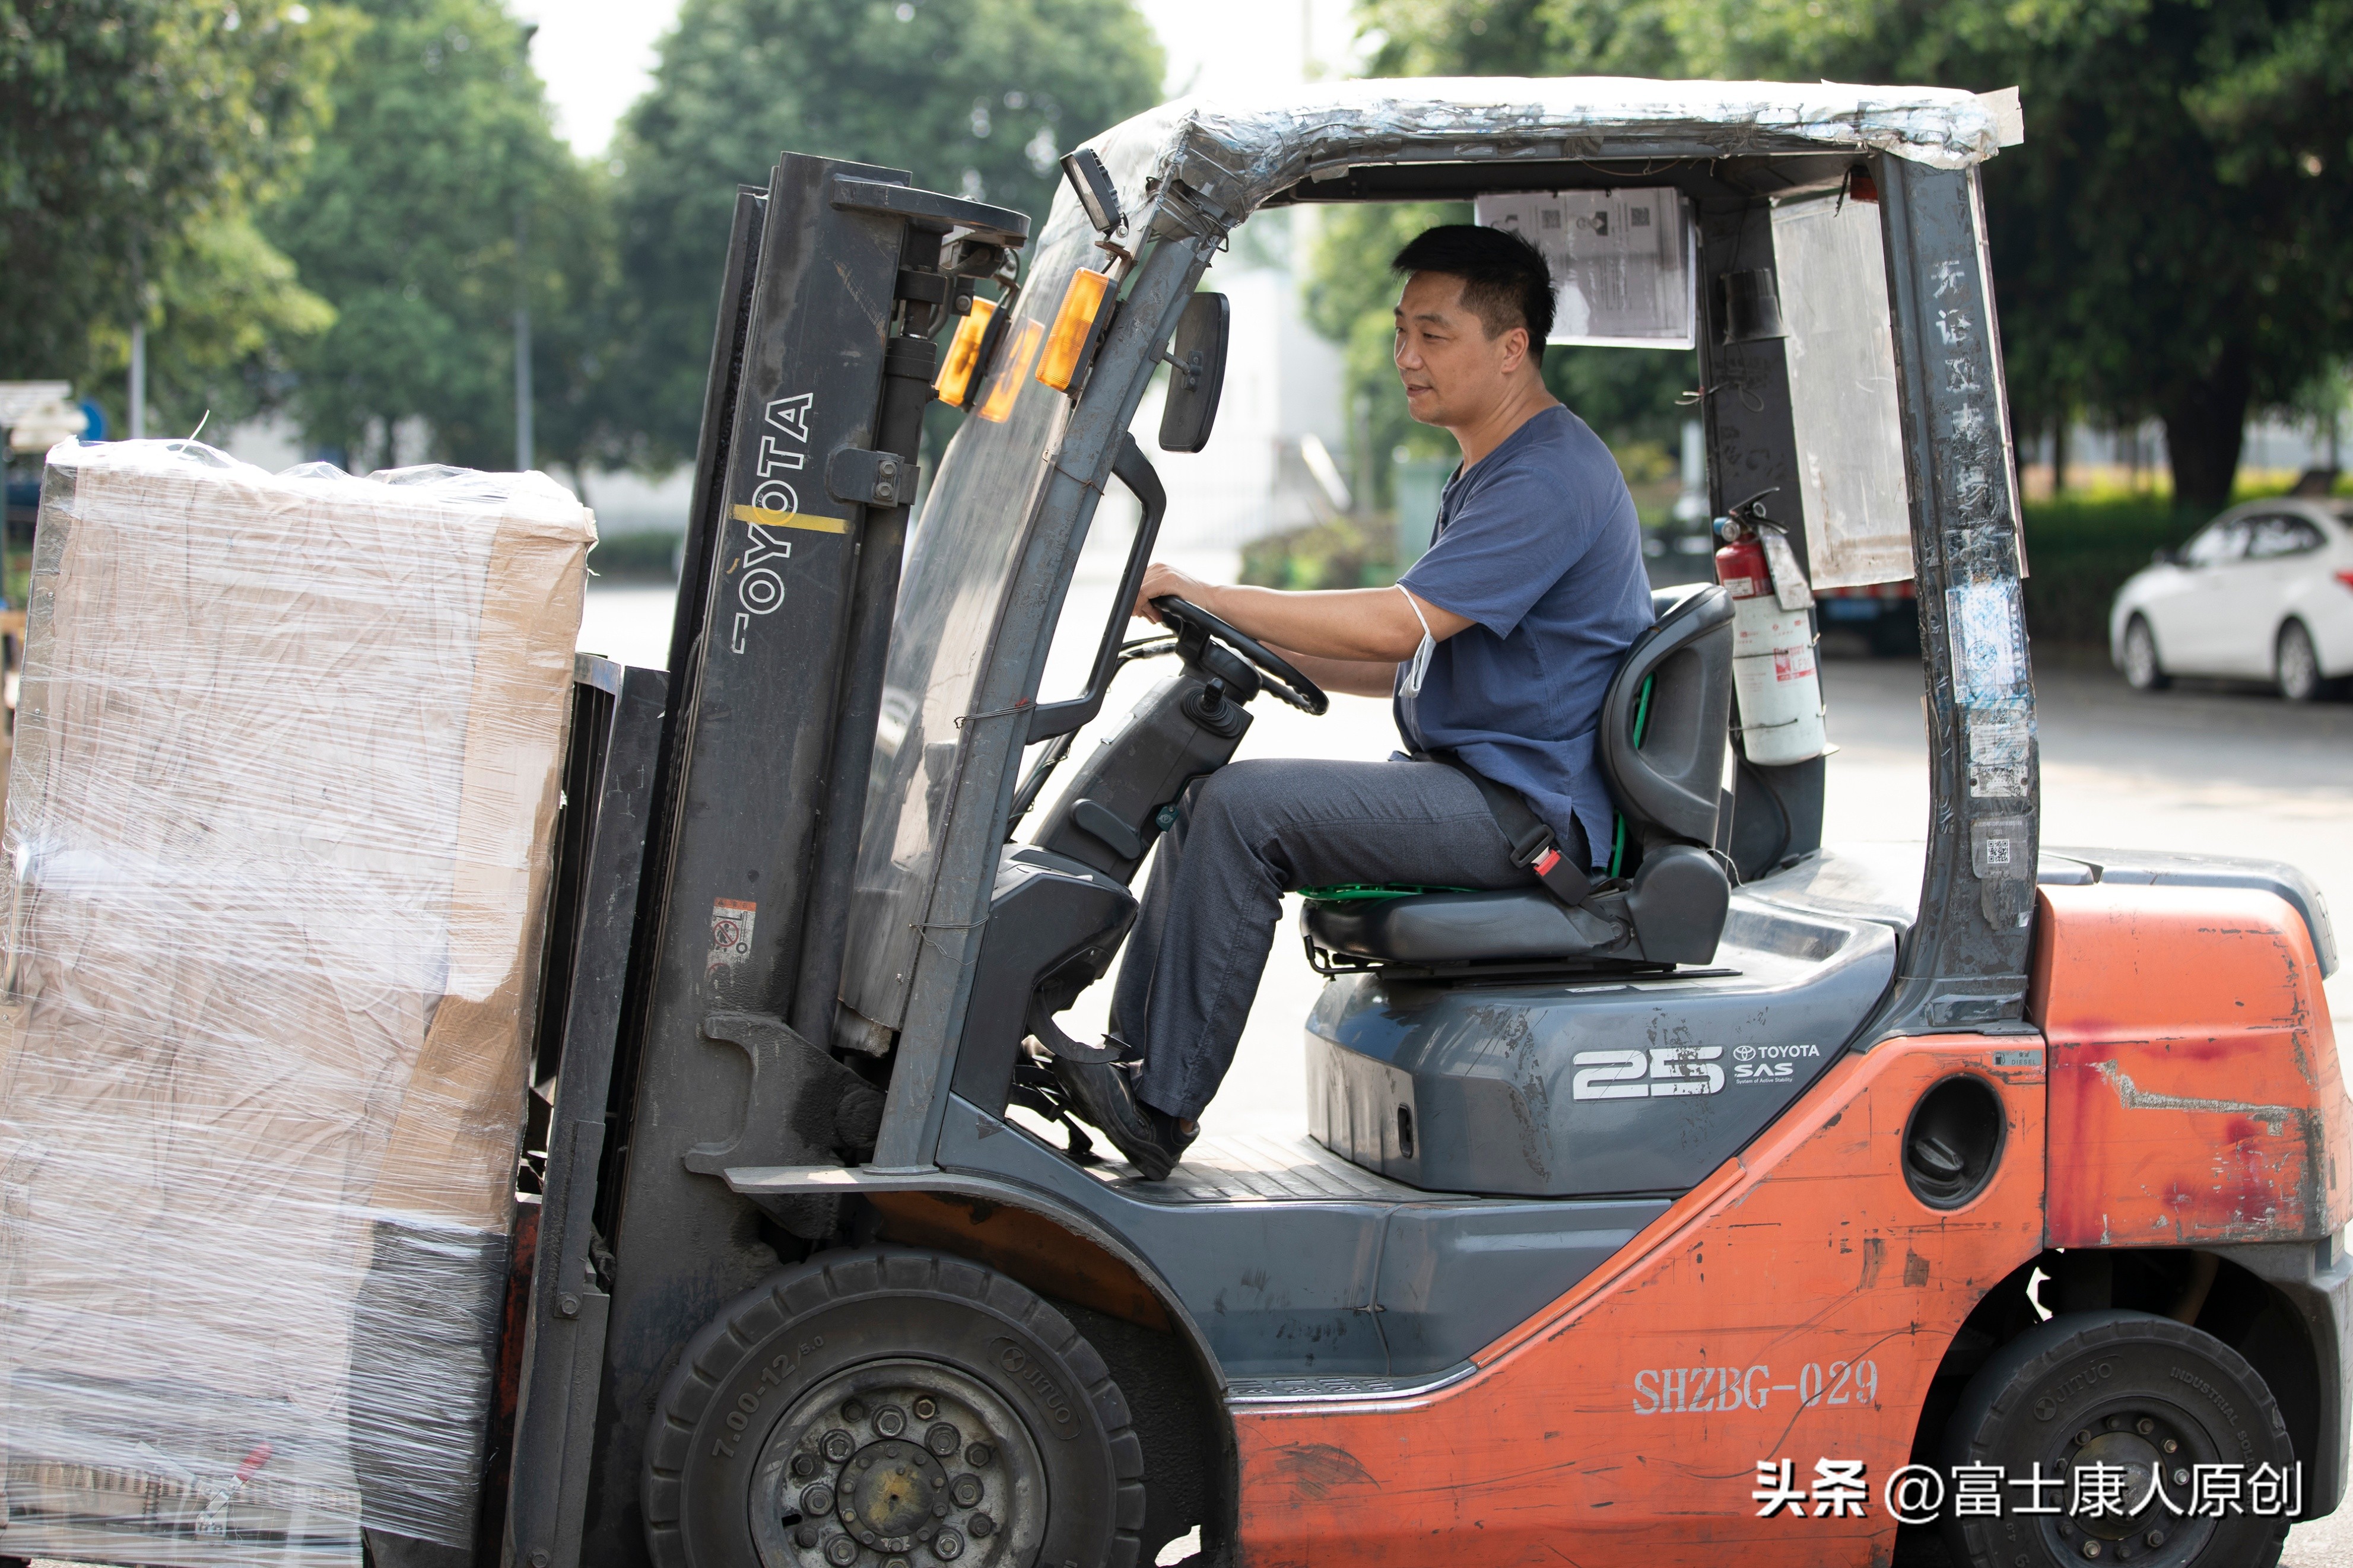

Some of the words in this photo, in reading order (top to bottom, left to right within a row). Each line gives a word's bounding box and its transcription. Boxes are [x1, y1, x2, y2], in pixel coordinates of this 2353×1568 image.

[1573, 1047, 1725, 1100] 25
[1734, 1063, 1793, 1077] SAS
[1758, 1045, 1820, 1059] TOYOTA
[1023, 1368, 1071, 1424] JITUO
[1633, 1360, 1878, 1416] SHZBG-029
[2056, 1363, 2113, 1404] JITUO
[2170, 1367, 2239, 1427] INDUSTRIAL
[2237, 1430, 2255, 1472] SOLID
